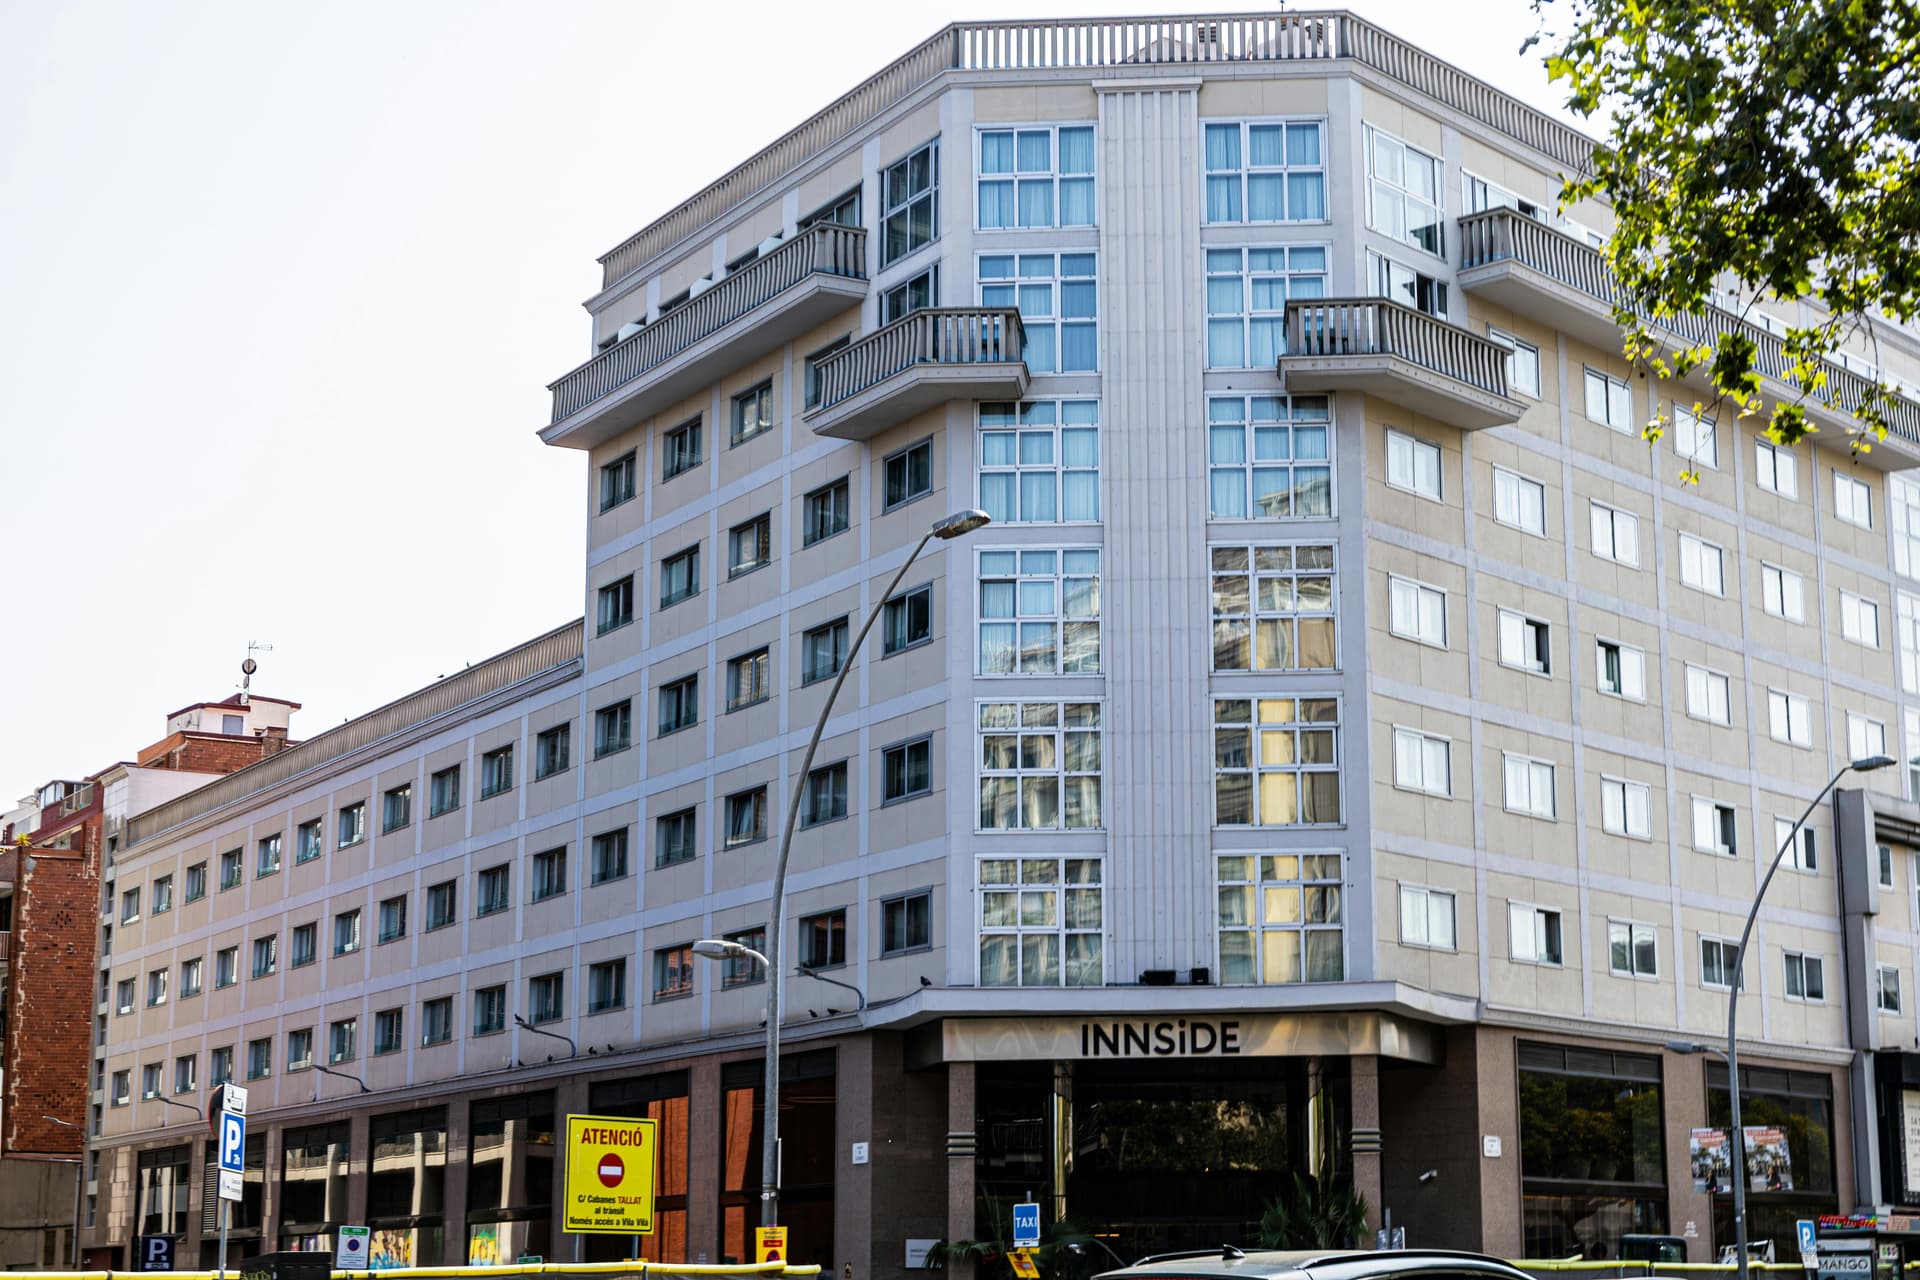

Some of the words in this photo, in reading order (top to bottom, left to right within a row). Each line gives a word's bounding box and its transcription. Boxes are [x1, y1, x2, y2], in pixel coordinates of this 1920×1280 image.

[1082, 1019, 1240, 1056] INNSiDE
[225, 1119, 241, 1163] P
[581, 1127, 642, 1147] ATENCIÓ
[578, 1194, 586, 1203] C/
[587, 1195, 616, 1204] Cabanes
[618, 1196, 642, 1205] TALLAT
[594, 1206, 601, 1214] al
[1015, 1216, 1037, 1229] TAXI
[1802, 1228, 1811, 1248] P
[148, 1238, 168, 1261] P
[1818, 1258, 1869, 1270] MANGO
